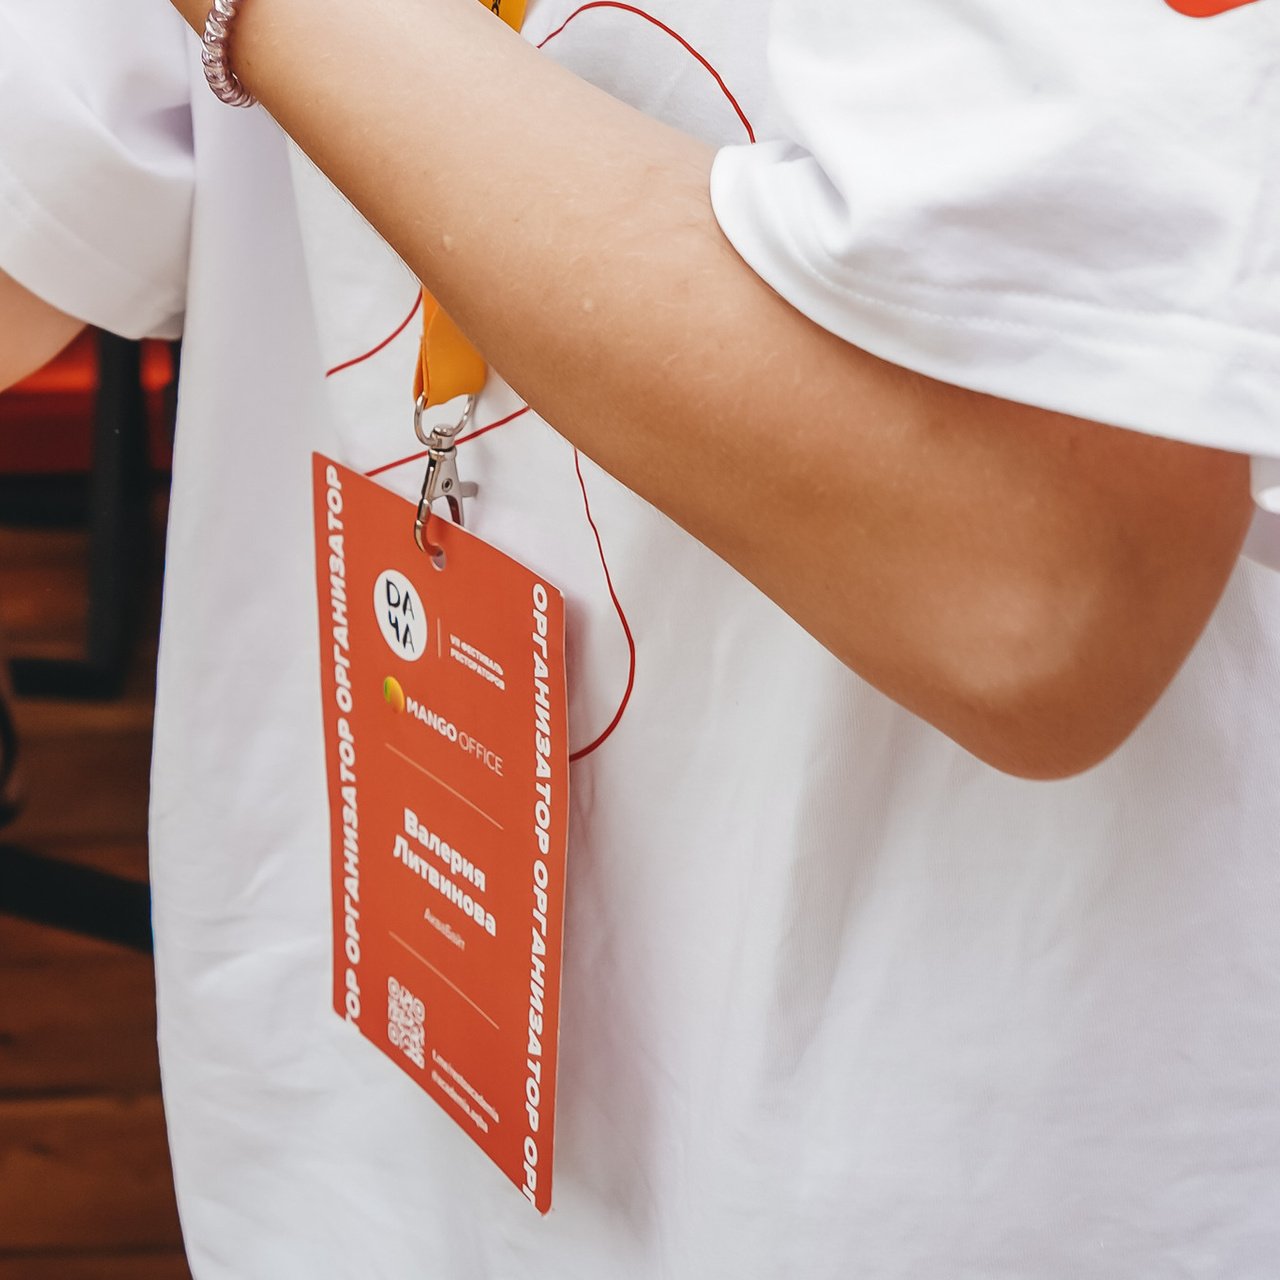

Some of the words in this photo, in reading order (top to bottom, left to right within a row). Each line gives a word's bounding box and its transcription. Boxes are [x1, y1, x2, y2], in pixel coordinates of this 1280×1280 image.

[326, 464, 354, 713] ОРГАНИЗАТОР
[337, 718, 360, 964] ОРГАНИЗАТОР
[406, 696, 458, 742] MANGO
[458, 731, 504, 777] OFFICE
[532, 583, 551, 855] ОРГАНИЗАТОР
[393, 833, 497, 937] Литвинова
[403, 807, 486, 893] Валерия
[525, 858, 550, 1132] ОРГАНИЗАТОР
